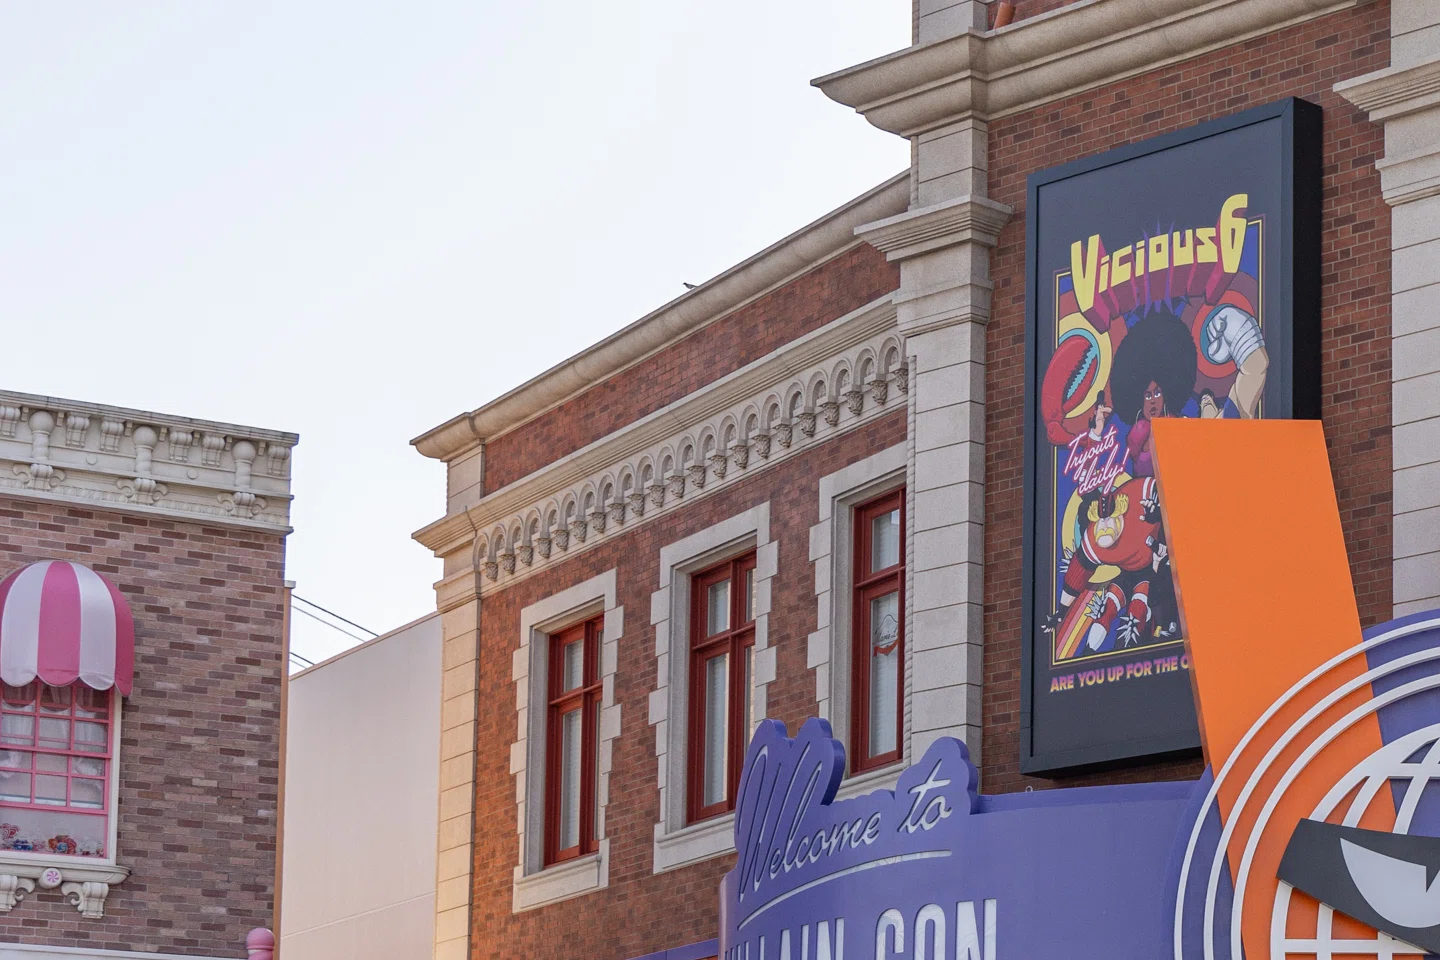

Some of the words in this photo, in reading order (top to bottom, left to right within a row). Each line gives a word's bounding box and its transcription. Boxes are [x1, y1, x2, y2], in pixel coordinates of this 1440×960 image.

[1064, 426, 1118, 480] Tryouts
[1078, 448, 1130, 494] daily!
[1050, 674, 1075, 693] ARE
[1077, 667, 1105, 687] YOU
[1106, 662, 1126, 682] UP
[1126, 660, 1153, 679] FOR
[1153, 655, 1179, 675] THE
[738, 739, 883, 903] Welcome
[897, 757, 953, 835] to
